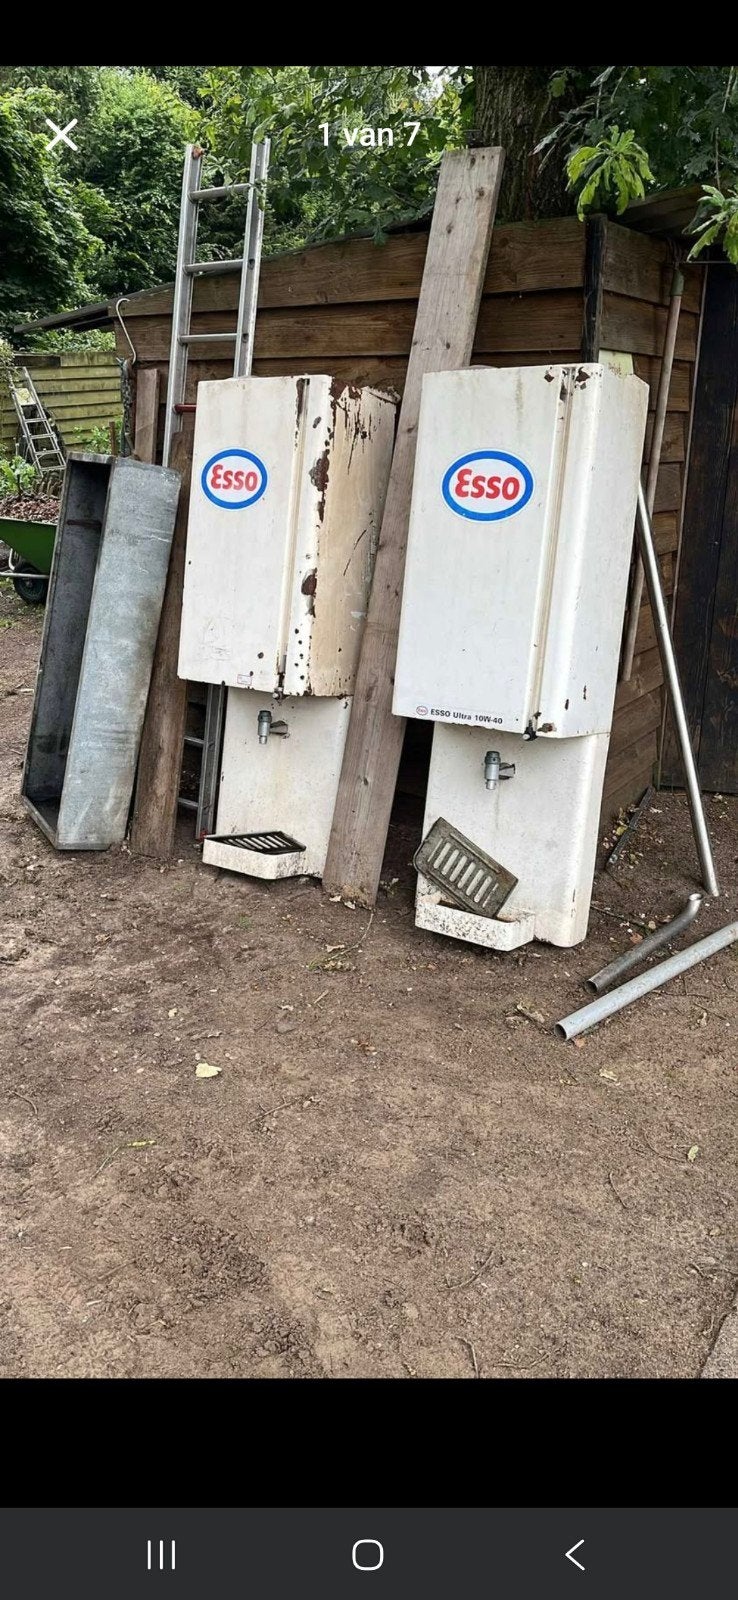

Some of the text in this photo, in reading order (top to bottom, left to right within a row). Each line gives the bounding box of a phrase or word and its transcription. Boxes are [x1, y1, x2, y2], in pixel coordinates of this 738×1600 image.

[430, 708, 451, 718] ESSO
[453, 711, 472, 720] Ultra
[475, 714, 503, 725] 10W-40
